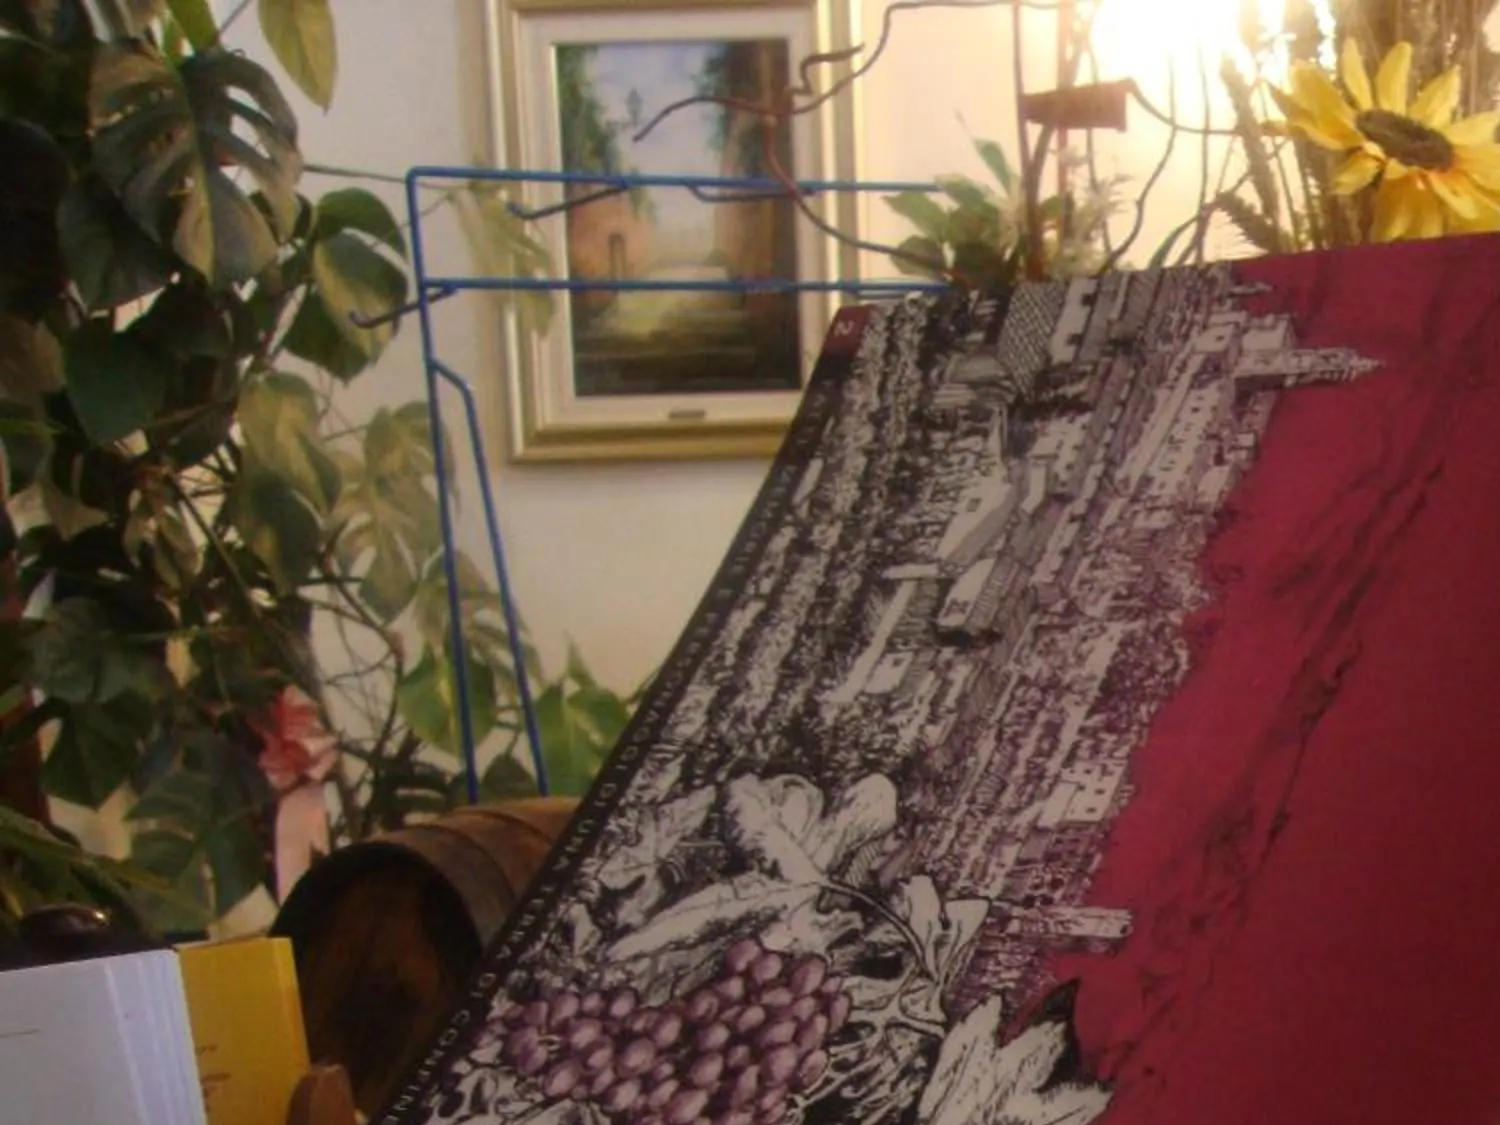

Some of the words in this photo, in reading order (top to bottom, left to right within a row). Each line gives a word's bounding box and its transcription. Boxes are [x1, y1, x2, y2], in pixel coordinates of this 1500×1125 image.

[594, 782, 617, 807] DI
[552, 818, 596, 871] UNA
[495, 884, 556, 960] TERRA
[470, 971, 498, 998] DI
